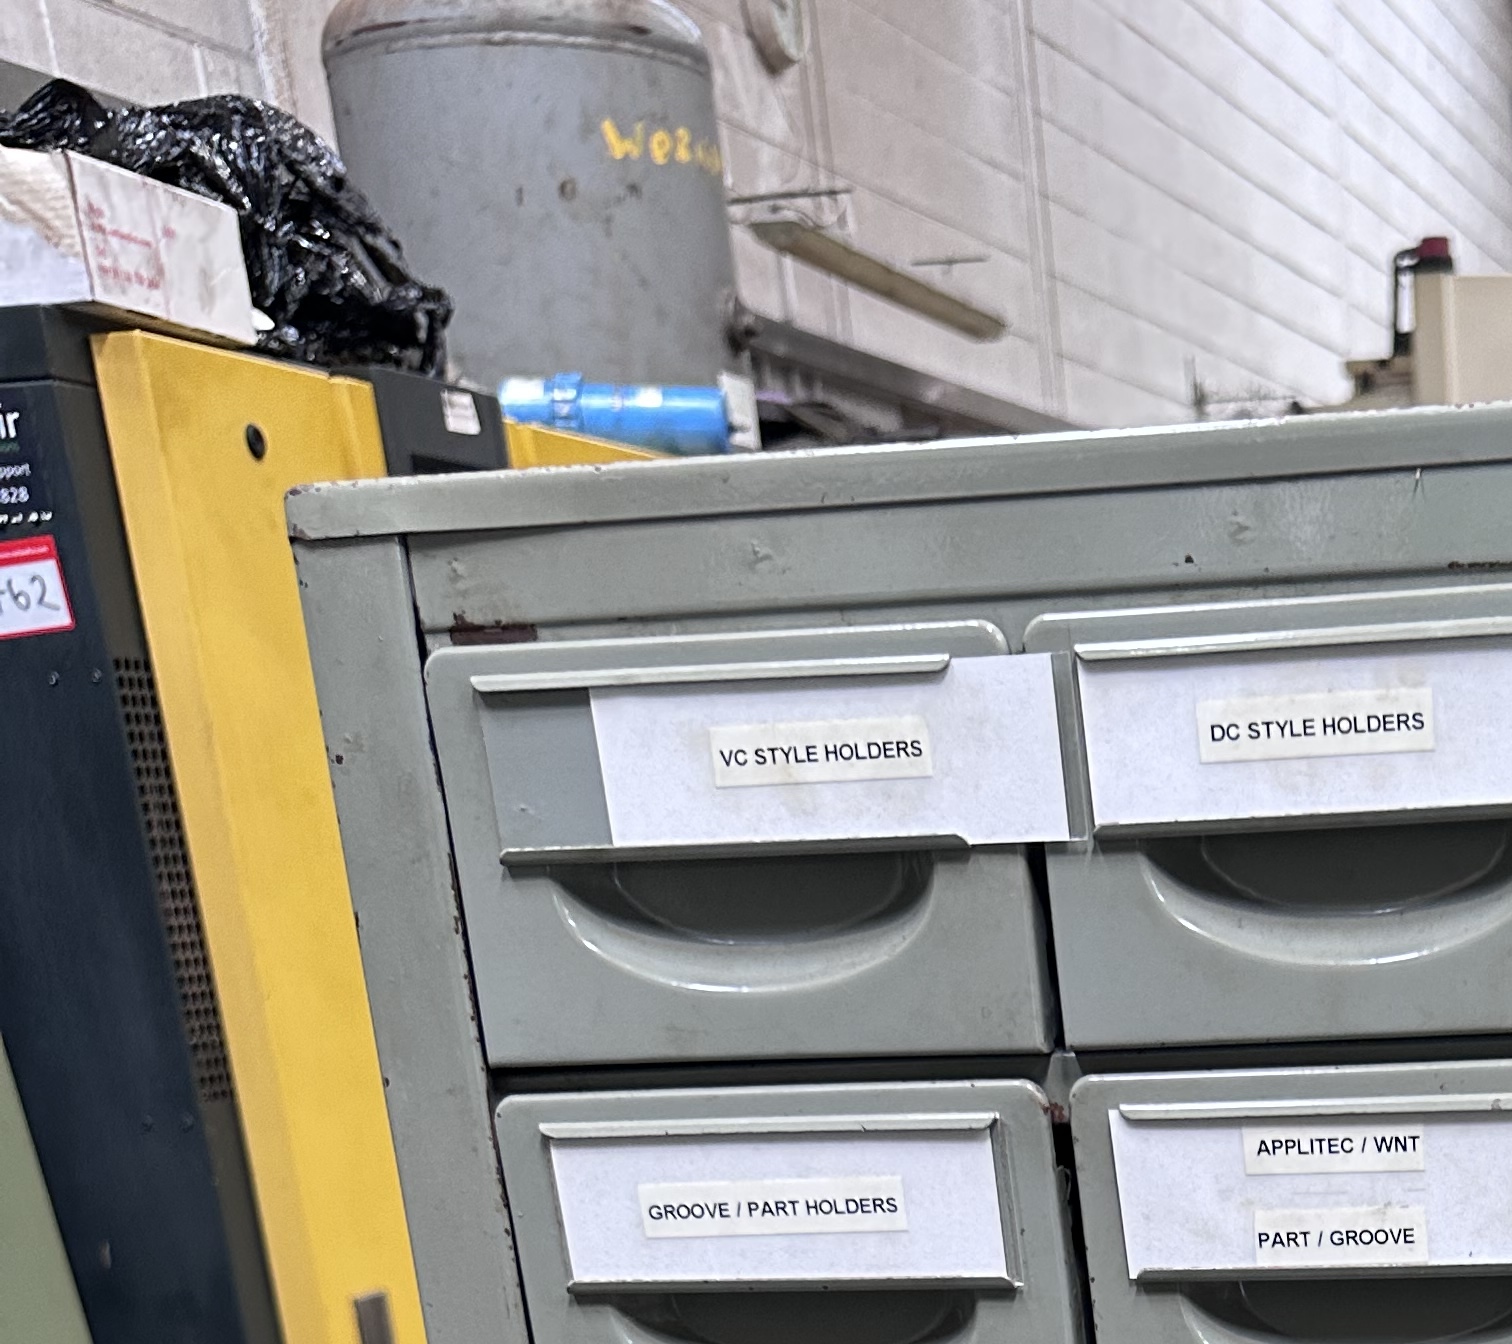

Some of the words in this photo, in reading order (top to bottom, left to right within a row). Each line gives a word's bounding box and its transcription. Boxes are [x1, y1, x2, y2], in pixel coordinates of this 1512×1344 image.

[1210, 721, 1242, 743] DC
[1247, 716, 1316, 740] STYLE
[1321, 711, 1425, 737] HOLDERS
[719, 747, 749, 768] VC
[754, 743, 819, 766] STYLE
[824, 739, 924, 762] HOLDERS
[1256, 1137, 1355, 1157] APPLITEC
[1360, 1136, 1368, 1154] /
[1373, 1135, 1421, 1153] WNT
[648, 1202, 731, 1221] GROOVE
[735, 1201, 742, 1218] /
[747, 1199, 800, 1218] PART
[806, 1197, 899, 1216] HOLDERS
[1257, 1231, 1311, 1249] PART
[1317, 1231, 1324, 1248] /
[1329, 1227, 1416, 1246] GROOVE
